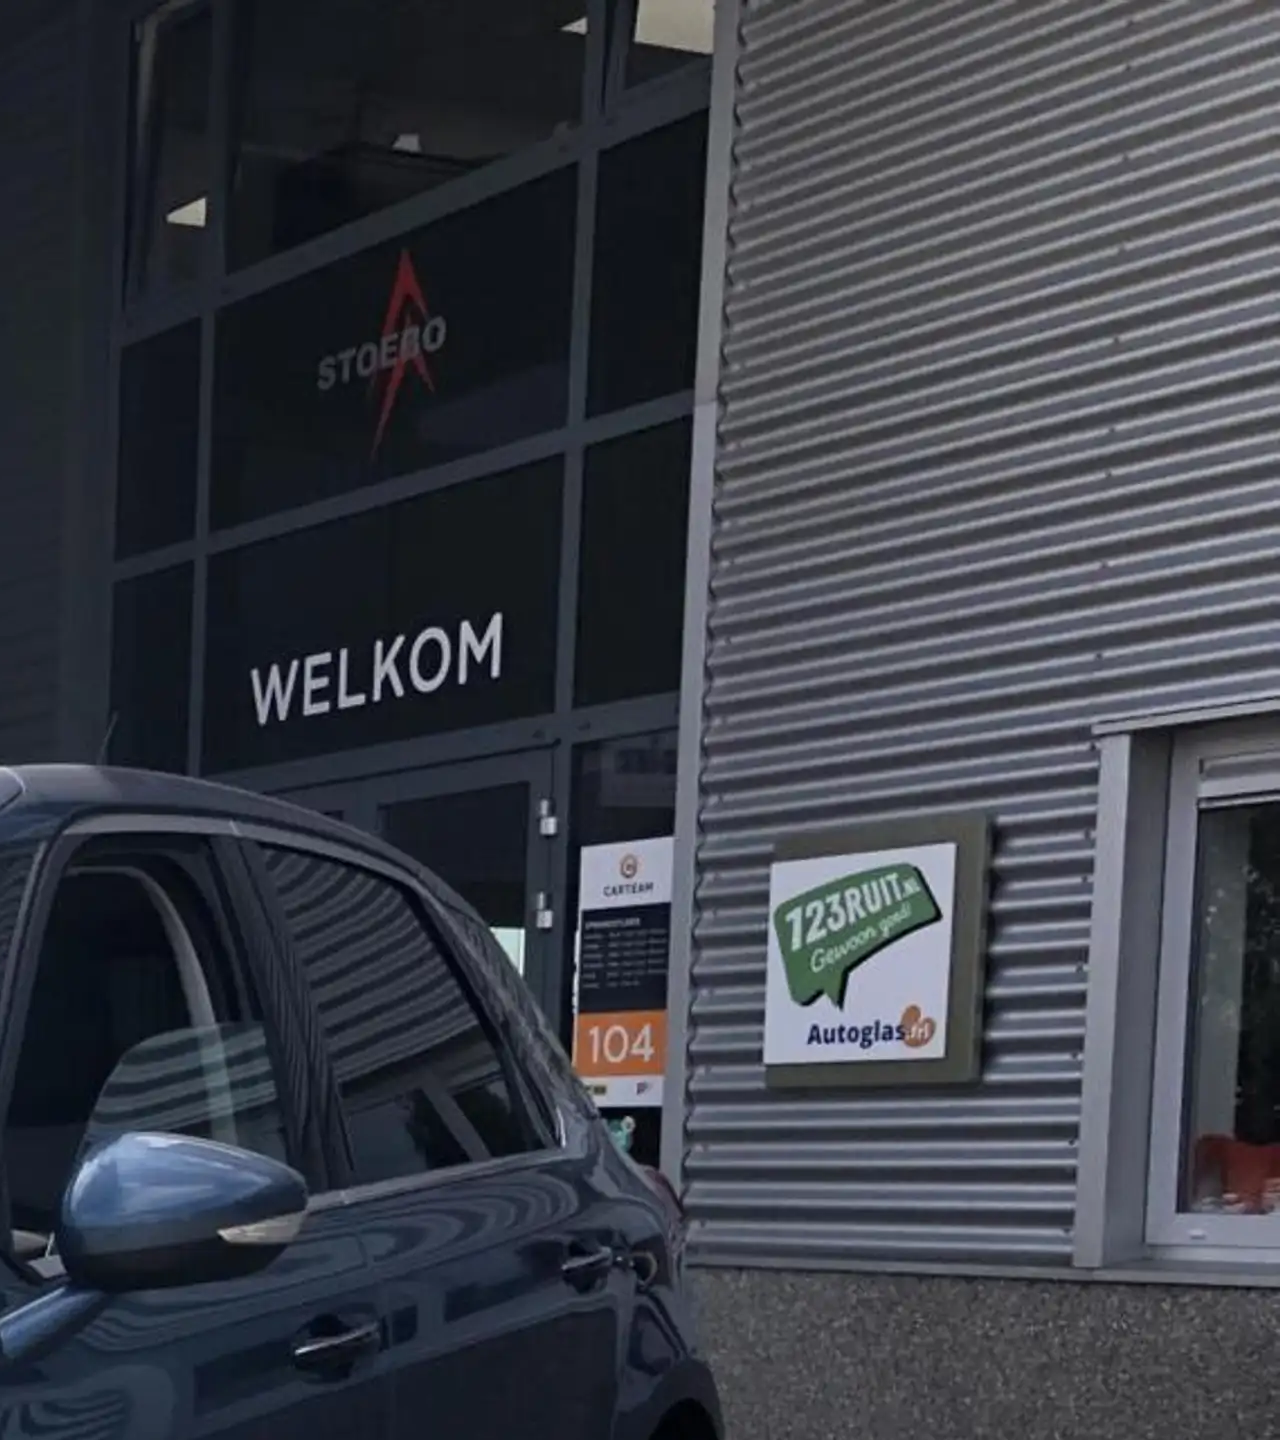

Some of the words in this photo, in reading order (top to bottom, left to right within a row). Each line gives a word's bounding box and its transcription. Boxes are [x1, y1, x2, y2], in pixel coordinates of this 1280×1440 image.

[316, 315, 447, 391] STOEBO
[250, 612, 503, 726] WELKOM
[603, 881, 654, 898] CARTEAM
[588, 1022, 655, 1064] 104
